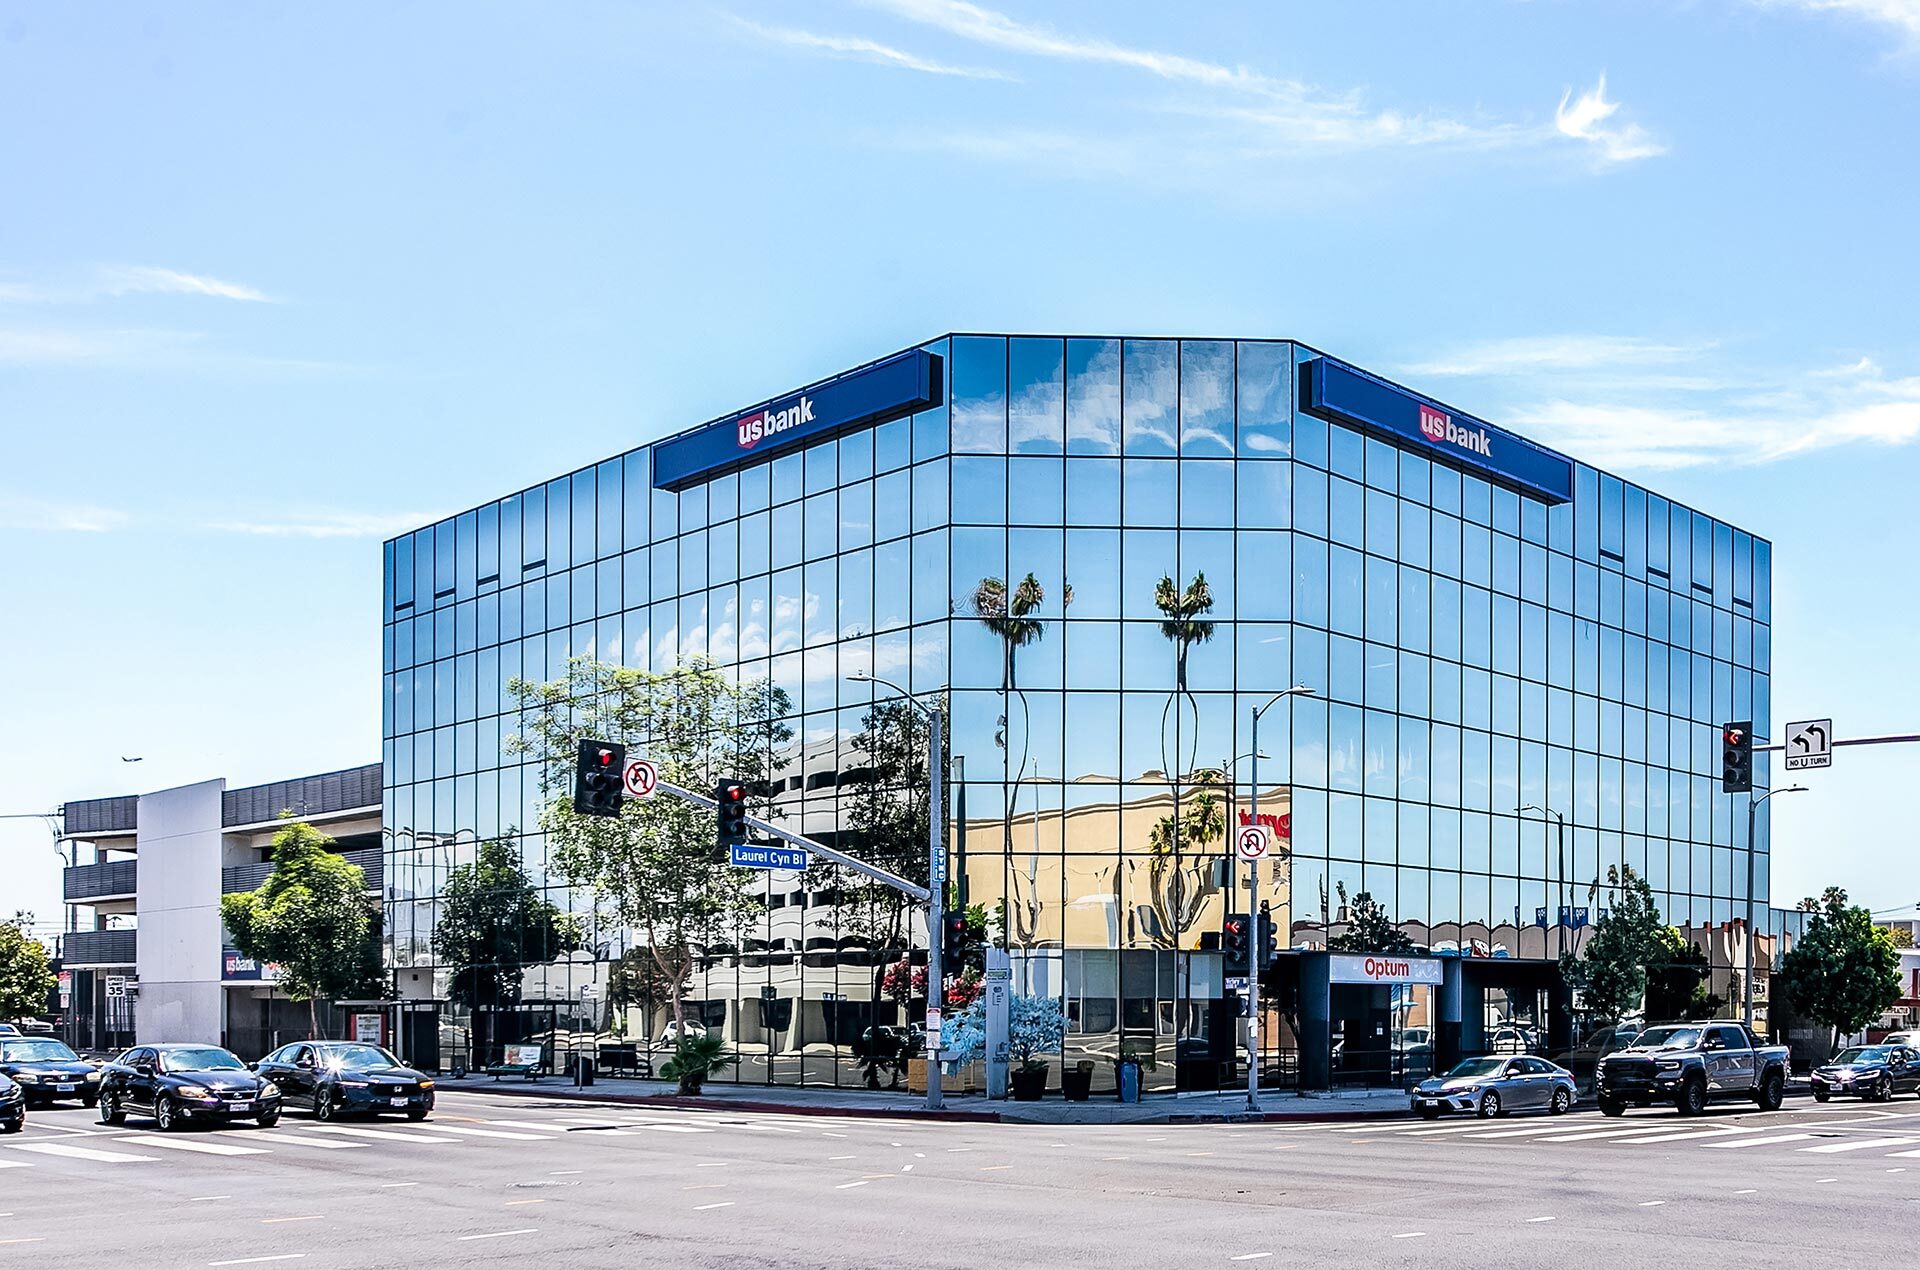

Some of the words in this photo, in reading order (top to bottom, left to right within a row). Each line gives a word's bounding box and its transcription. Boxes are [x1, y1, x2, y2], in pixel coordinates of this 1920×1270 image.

[1800, 758, 1808, 767] U
[1810, 757, 1827, 765] TURN
[735, 848, 768, 862] Laurel
[770, 851, 790, 866] Cyn
[792, 853, 804, 865] Bl
[1364, 957, 1409, 980] Optum
[108, 986, 123, 996] 35
